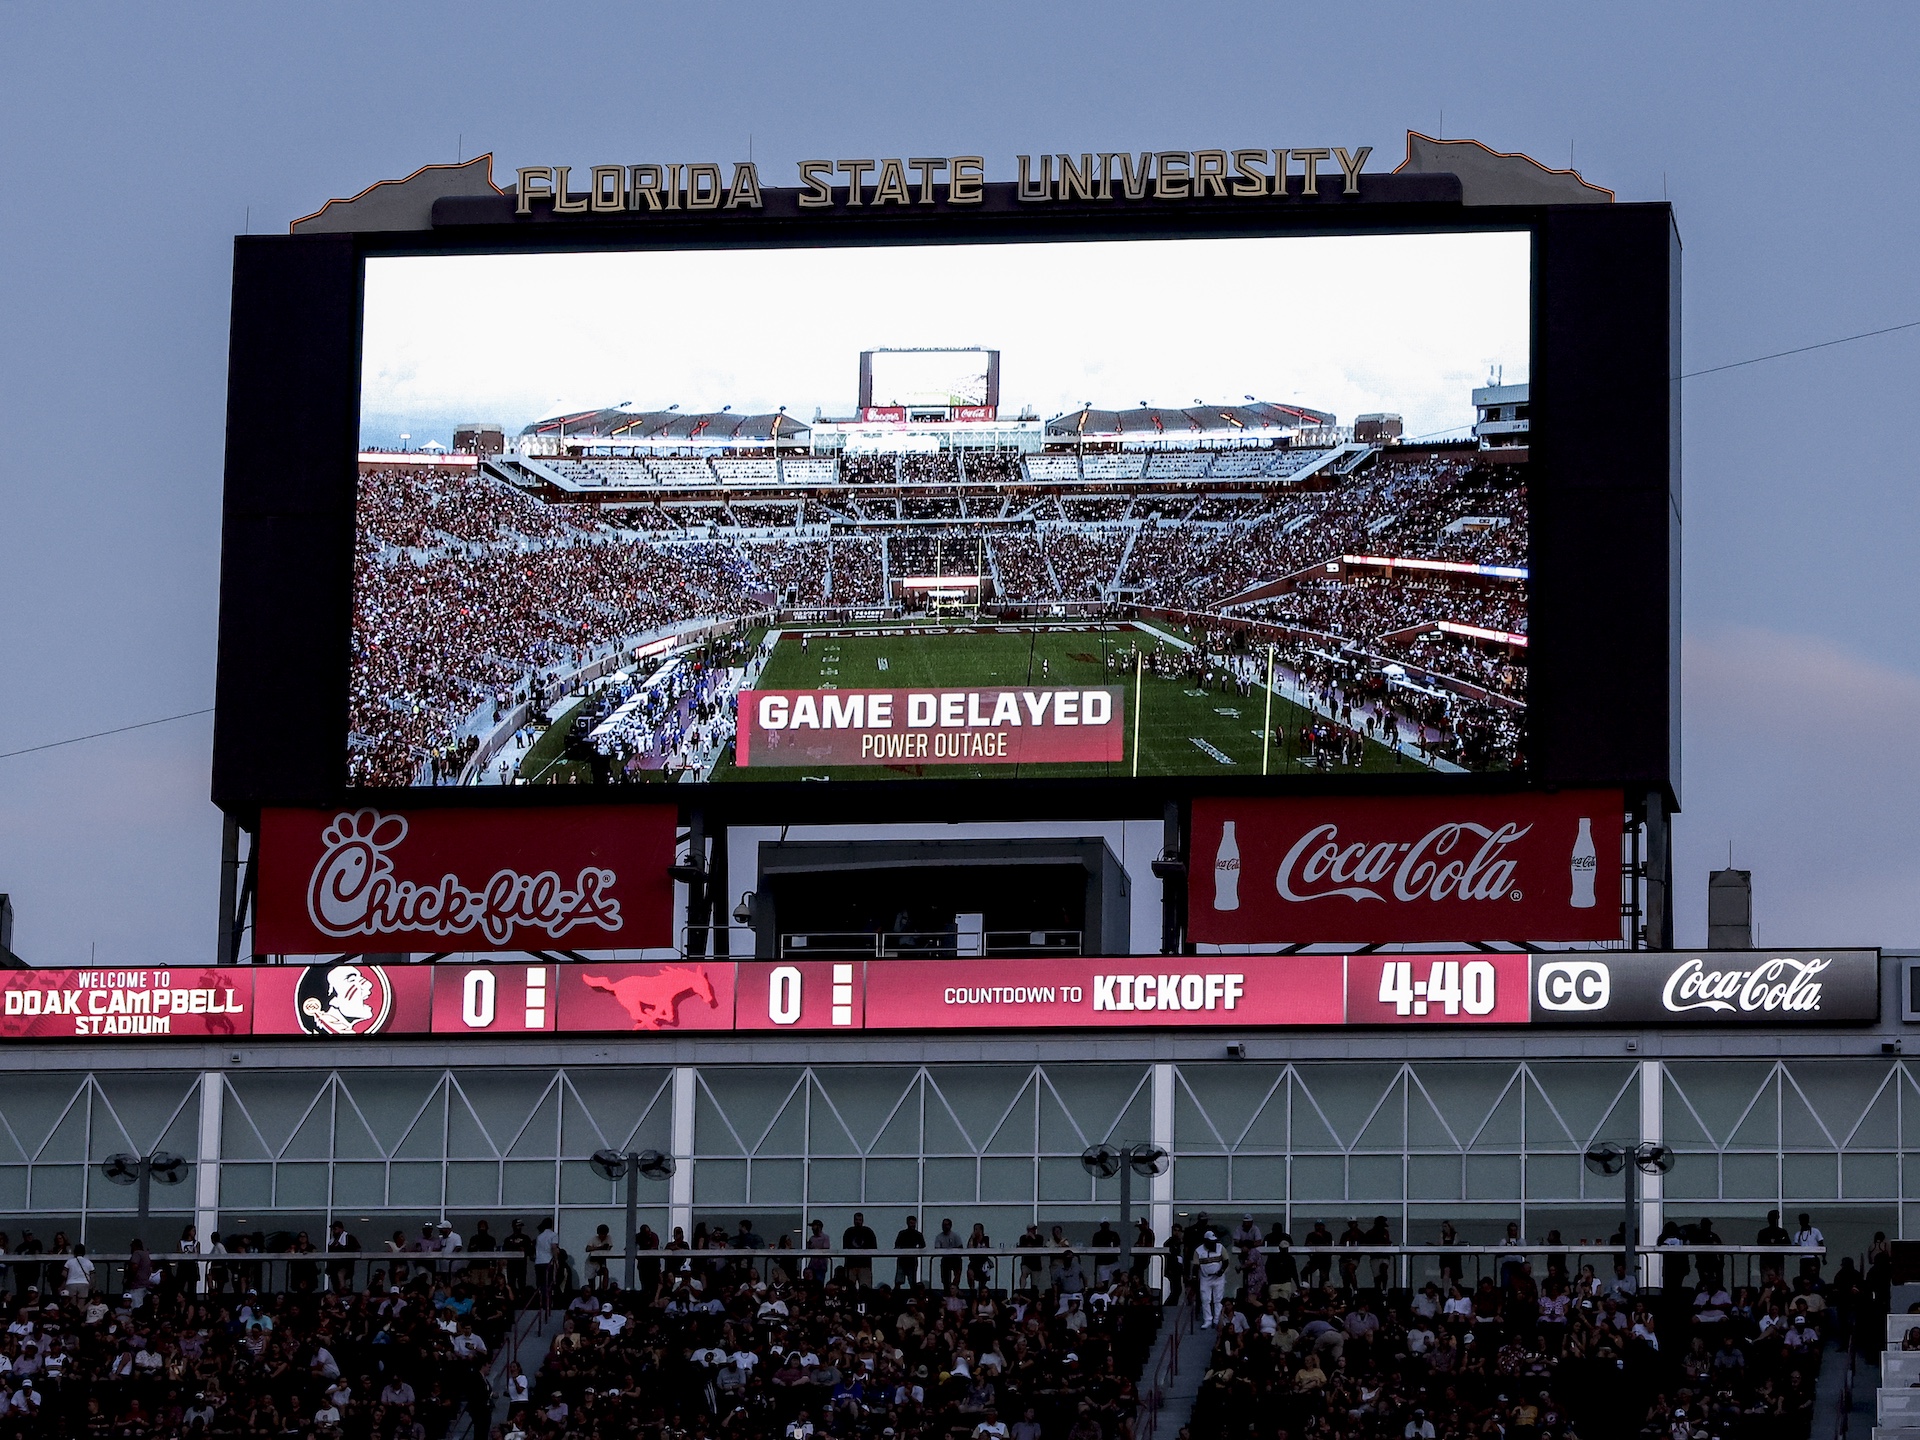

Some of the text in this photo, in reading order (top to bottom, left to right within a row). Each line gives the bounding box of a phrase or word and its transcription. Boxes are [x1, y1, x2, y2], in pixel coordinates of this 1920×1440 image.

[515, 147, 1373, 215] FLORIDA STATE UNIVERSITY
[758, 690, 1112, 730] GAME DELAYED
[861, 732, 1008, 759] POWER OUTAGE
[307, 808, 623, 945] Chick-fil-A
[1276, 822, 1534, 903] Coca-Cola
[4, 988, 244, 1016] DOAK CAMPBELL
[78, 971, 170, 988] WELCOME TO
[462, 970, 496, 1027] 0
[768, 966, 802, 1025] 0
[944, 974, 1244, 1011] COUNTDOWN TO KICKOFF
[1378, 961, 1495, 1015] 4:40
[1543, 967, 1604, 1007] CC
[1662, 958, 1832, 1012] Coca-Cola
[75, 1015, 170, 1035] STADIUM
